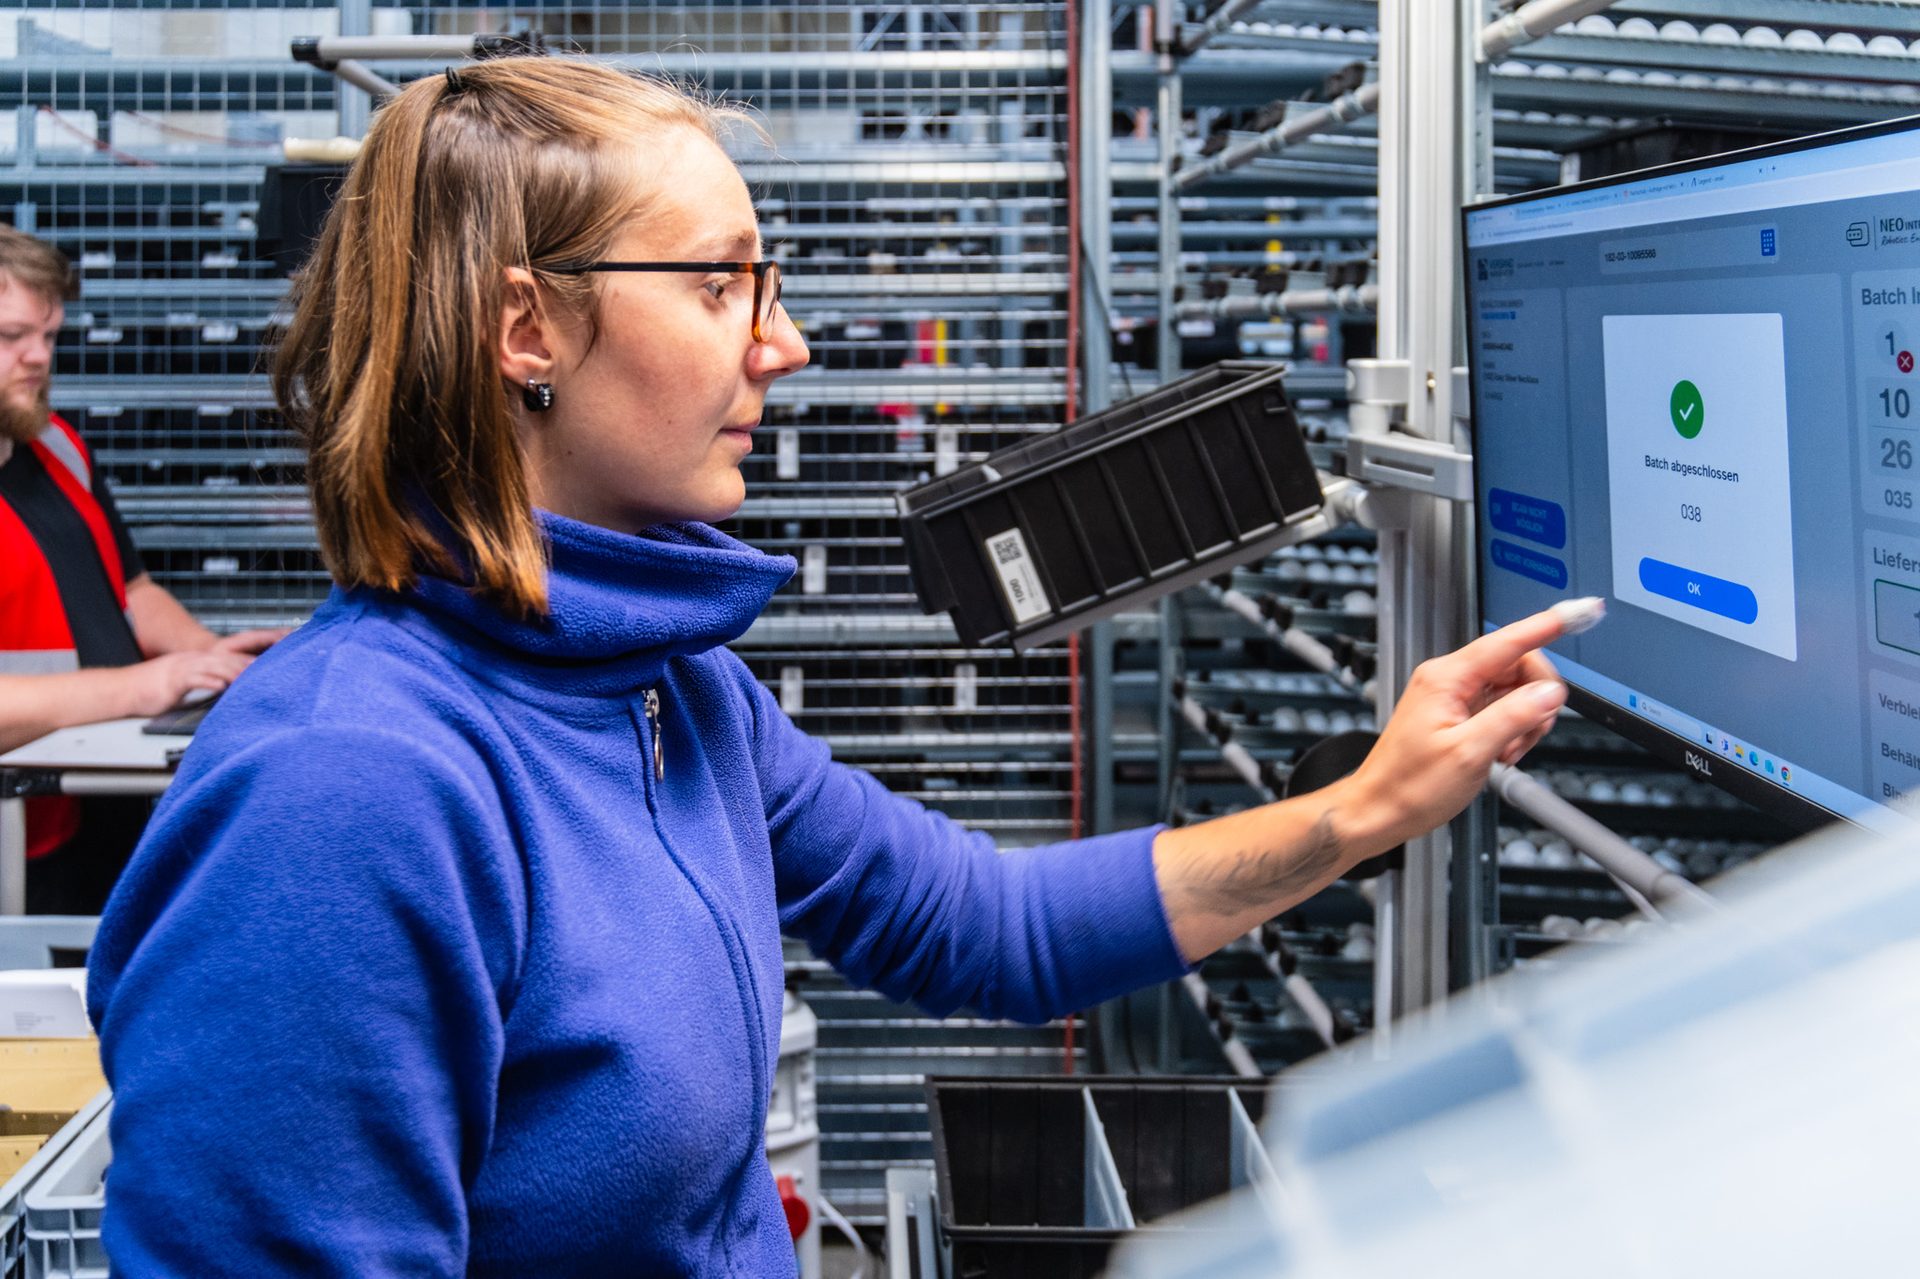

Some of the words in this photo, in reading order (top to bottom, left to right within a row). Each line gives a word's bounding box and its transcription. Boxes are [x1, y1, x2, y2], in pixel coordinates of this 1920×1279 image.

[1880, 217, 1904, 232] NEO
[1861, 286, 1907, 305] Batch
[1885, 331, 1895, 356] 1
[1879, 388, 1910, 418] 10
[1880, 437, 1913, 470] 26
[1645, 455, 1669, 471] Batch
[1671, 460, 1739, 483] abgeschlossen
[1884, 489, 1913, 509] 035
[1681, 503, 1702, 522] 038
[1687, 582, 1701, 596] OK
[1684, 750, 1713, 777] DELL
